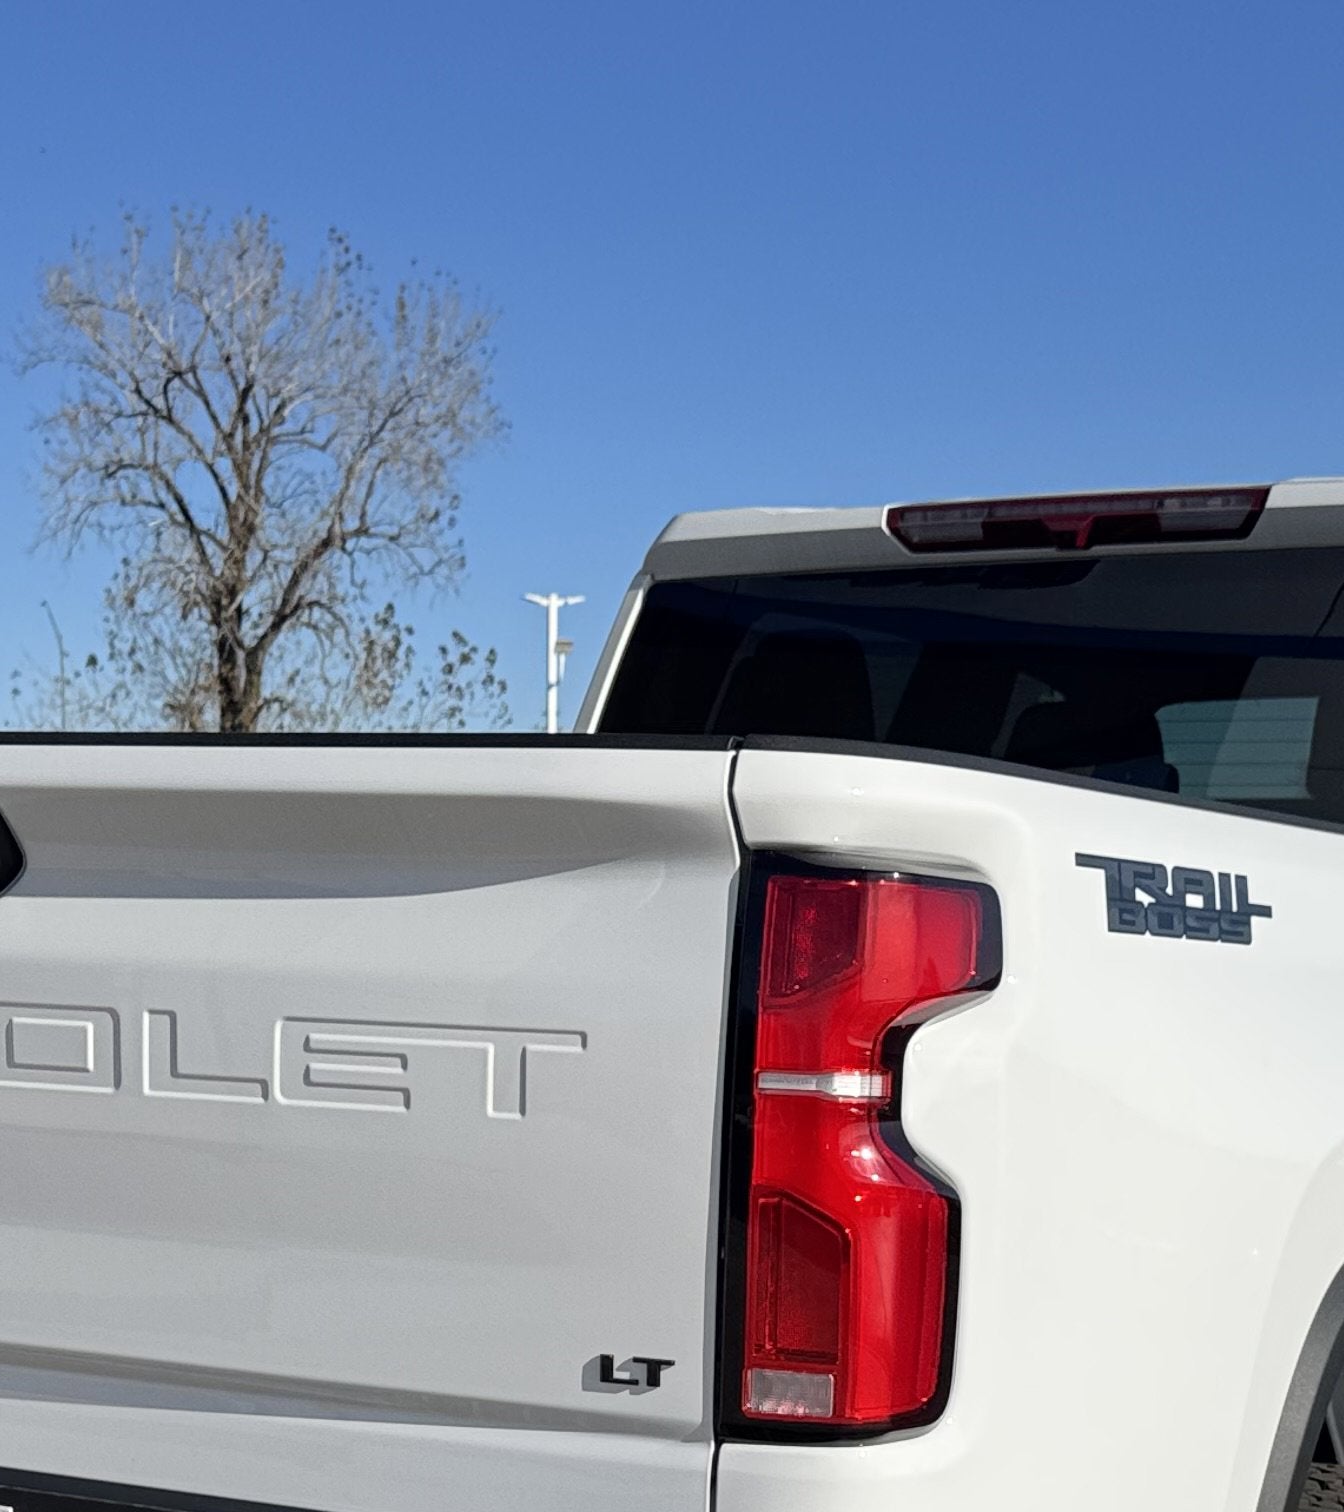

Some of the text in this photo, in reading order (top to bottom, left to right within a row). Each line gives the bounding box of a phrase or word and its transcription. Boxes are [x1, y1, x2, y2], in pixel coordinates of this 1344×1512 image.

[1075, 852, 1272, 918] TRAIL
[1107, 900, 1252, 945] BOSS
[600, 1354, 676, 1388] LT
